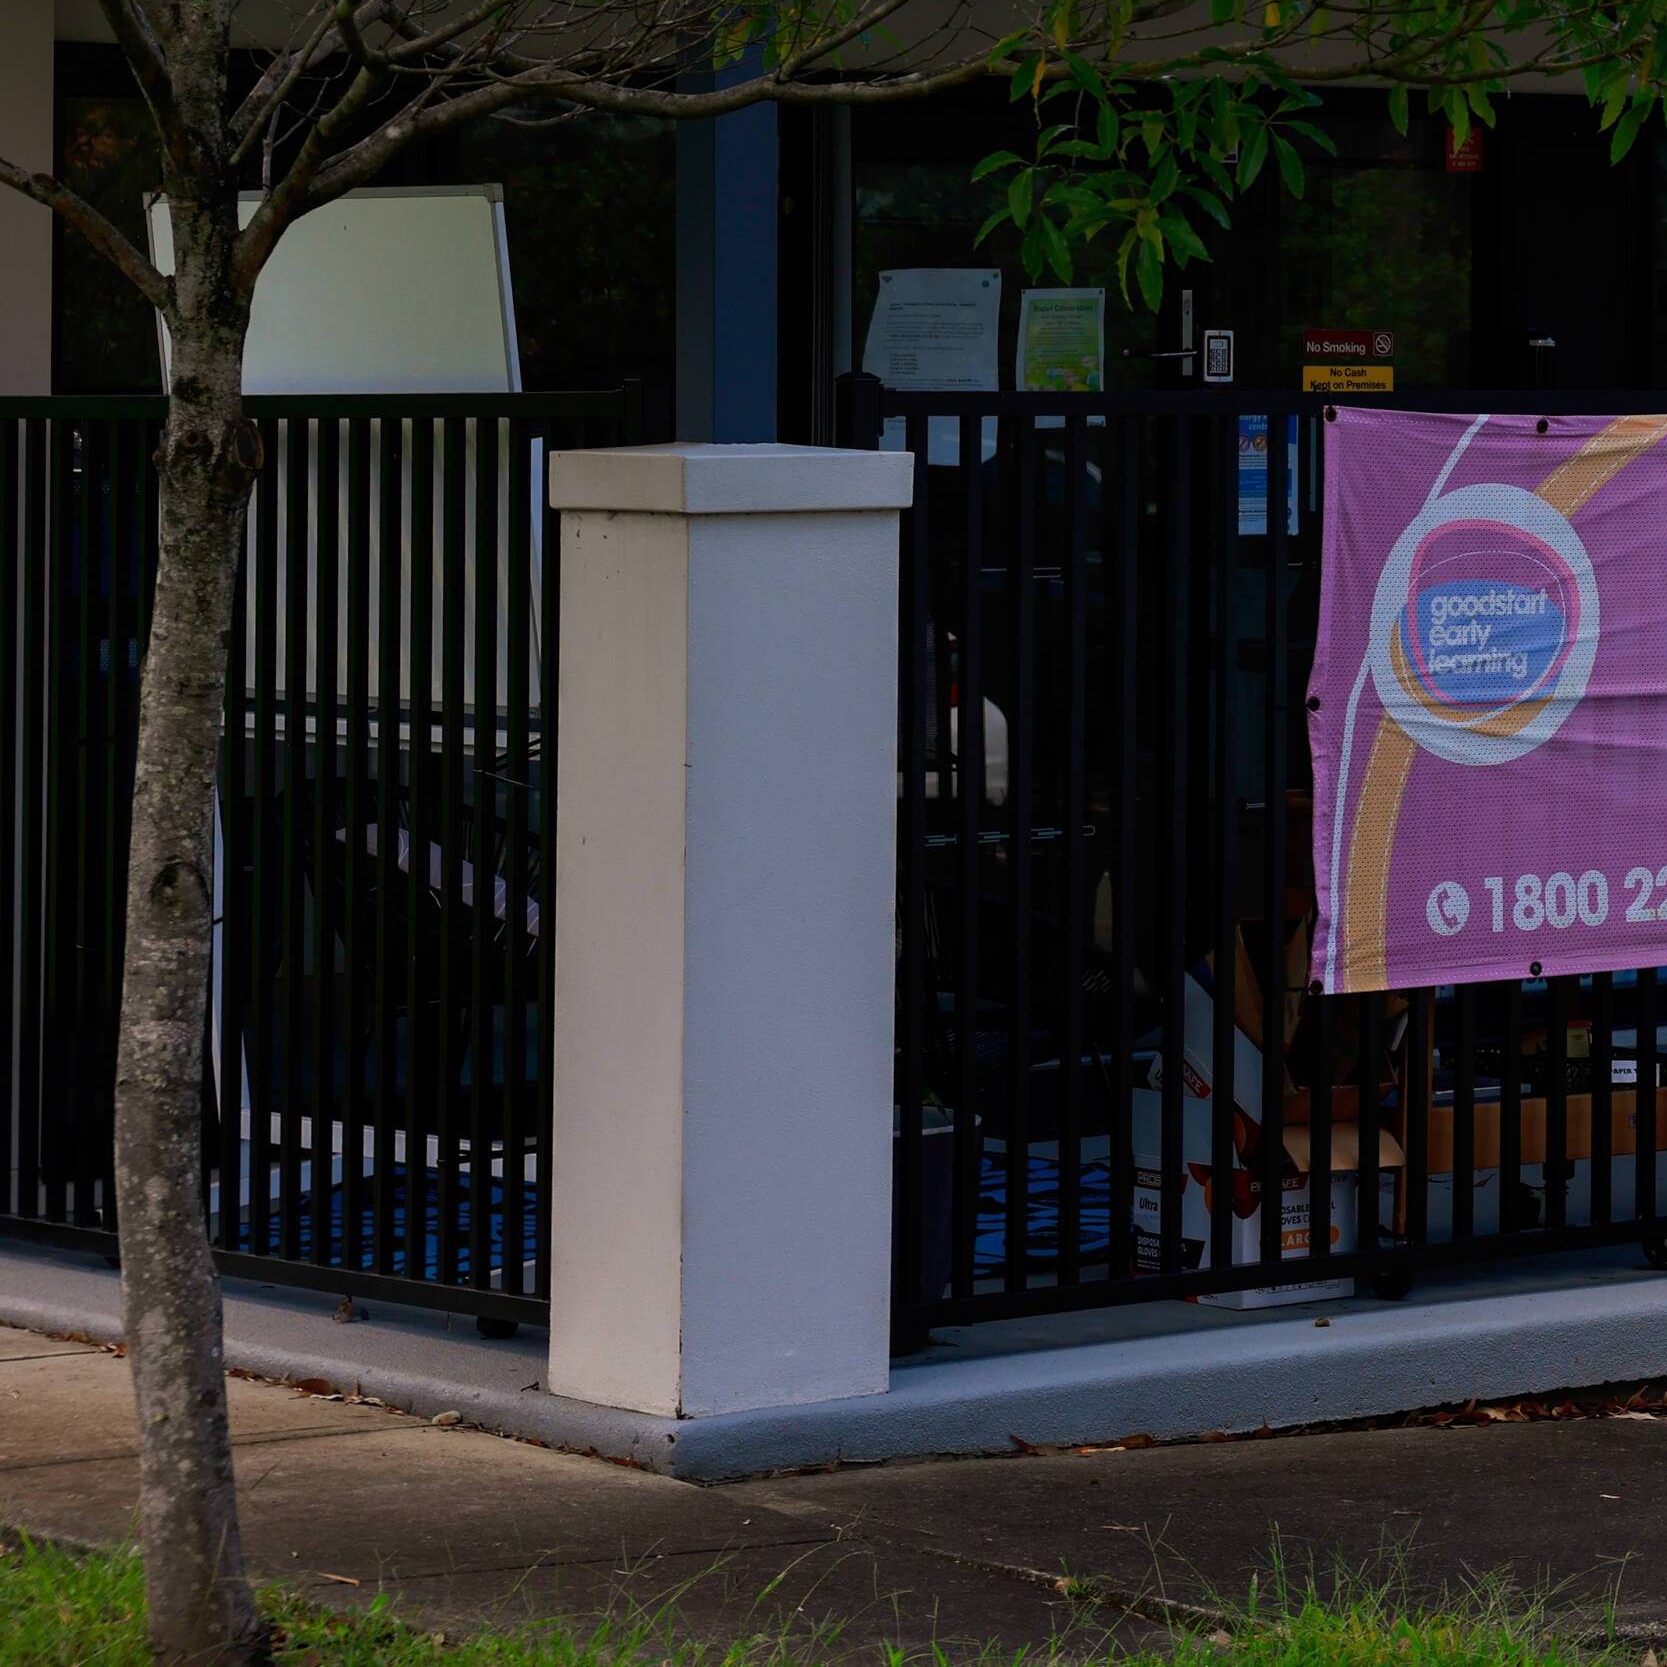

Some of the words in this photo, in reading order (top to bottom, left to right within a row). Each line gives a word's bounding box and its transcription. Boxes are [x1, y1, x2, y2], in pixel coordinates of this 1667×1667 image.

[1306, 341, 1321, 353] No
[1322, 341, 1366, 355] Smoking
[1330, 368, 1342, 377] No
[1344, 368, 1367, 377] Cash
[1347, 380, 1386, 389] Premises
[1431, 588, 1548, 625] goodstart
[1429, 619, 1491, 651] early
[1429, 647, 1528, 679] learning
[1484, 870, 1610, 932] 1800
[1139, 1197, 1158, 1212] Ultra
